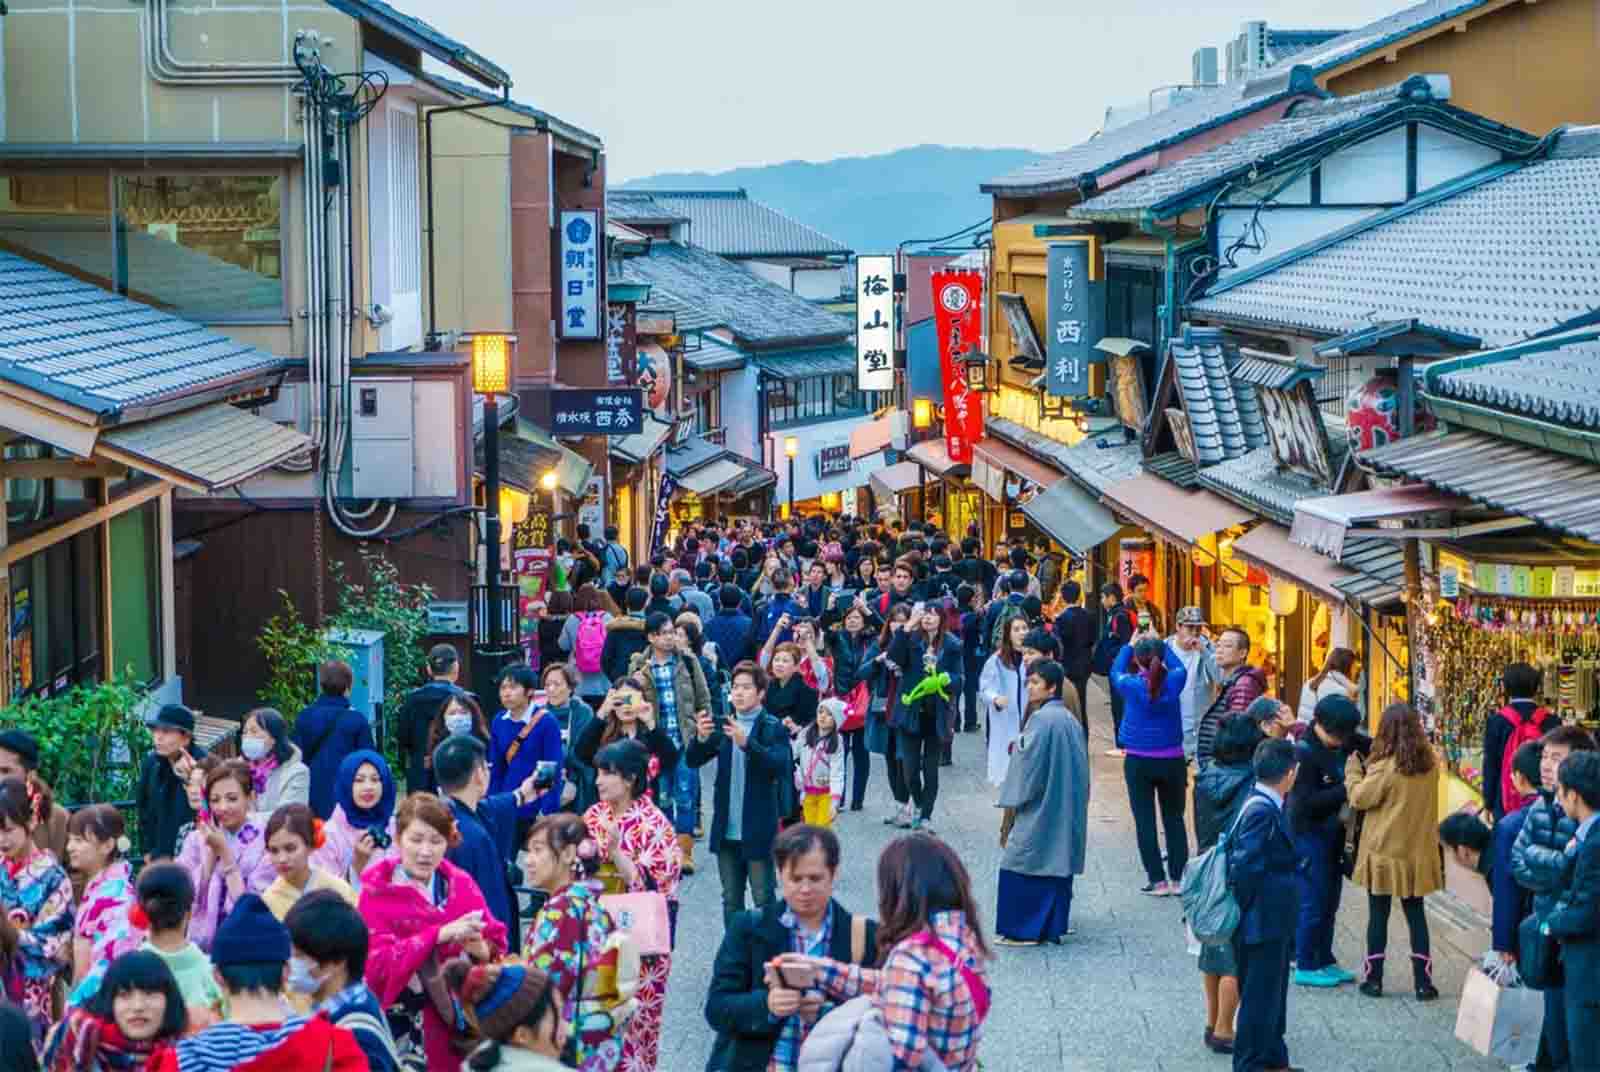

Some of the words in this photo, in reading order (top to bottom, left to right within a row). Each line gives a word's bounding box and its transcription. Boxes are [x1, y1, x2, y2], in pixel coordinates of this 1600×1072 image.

[566, 249, 586, 329] 朝日堂
[863, 274, 892, 373] 梅山堂
[1055, 319, 1081, 384] 西利
